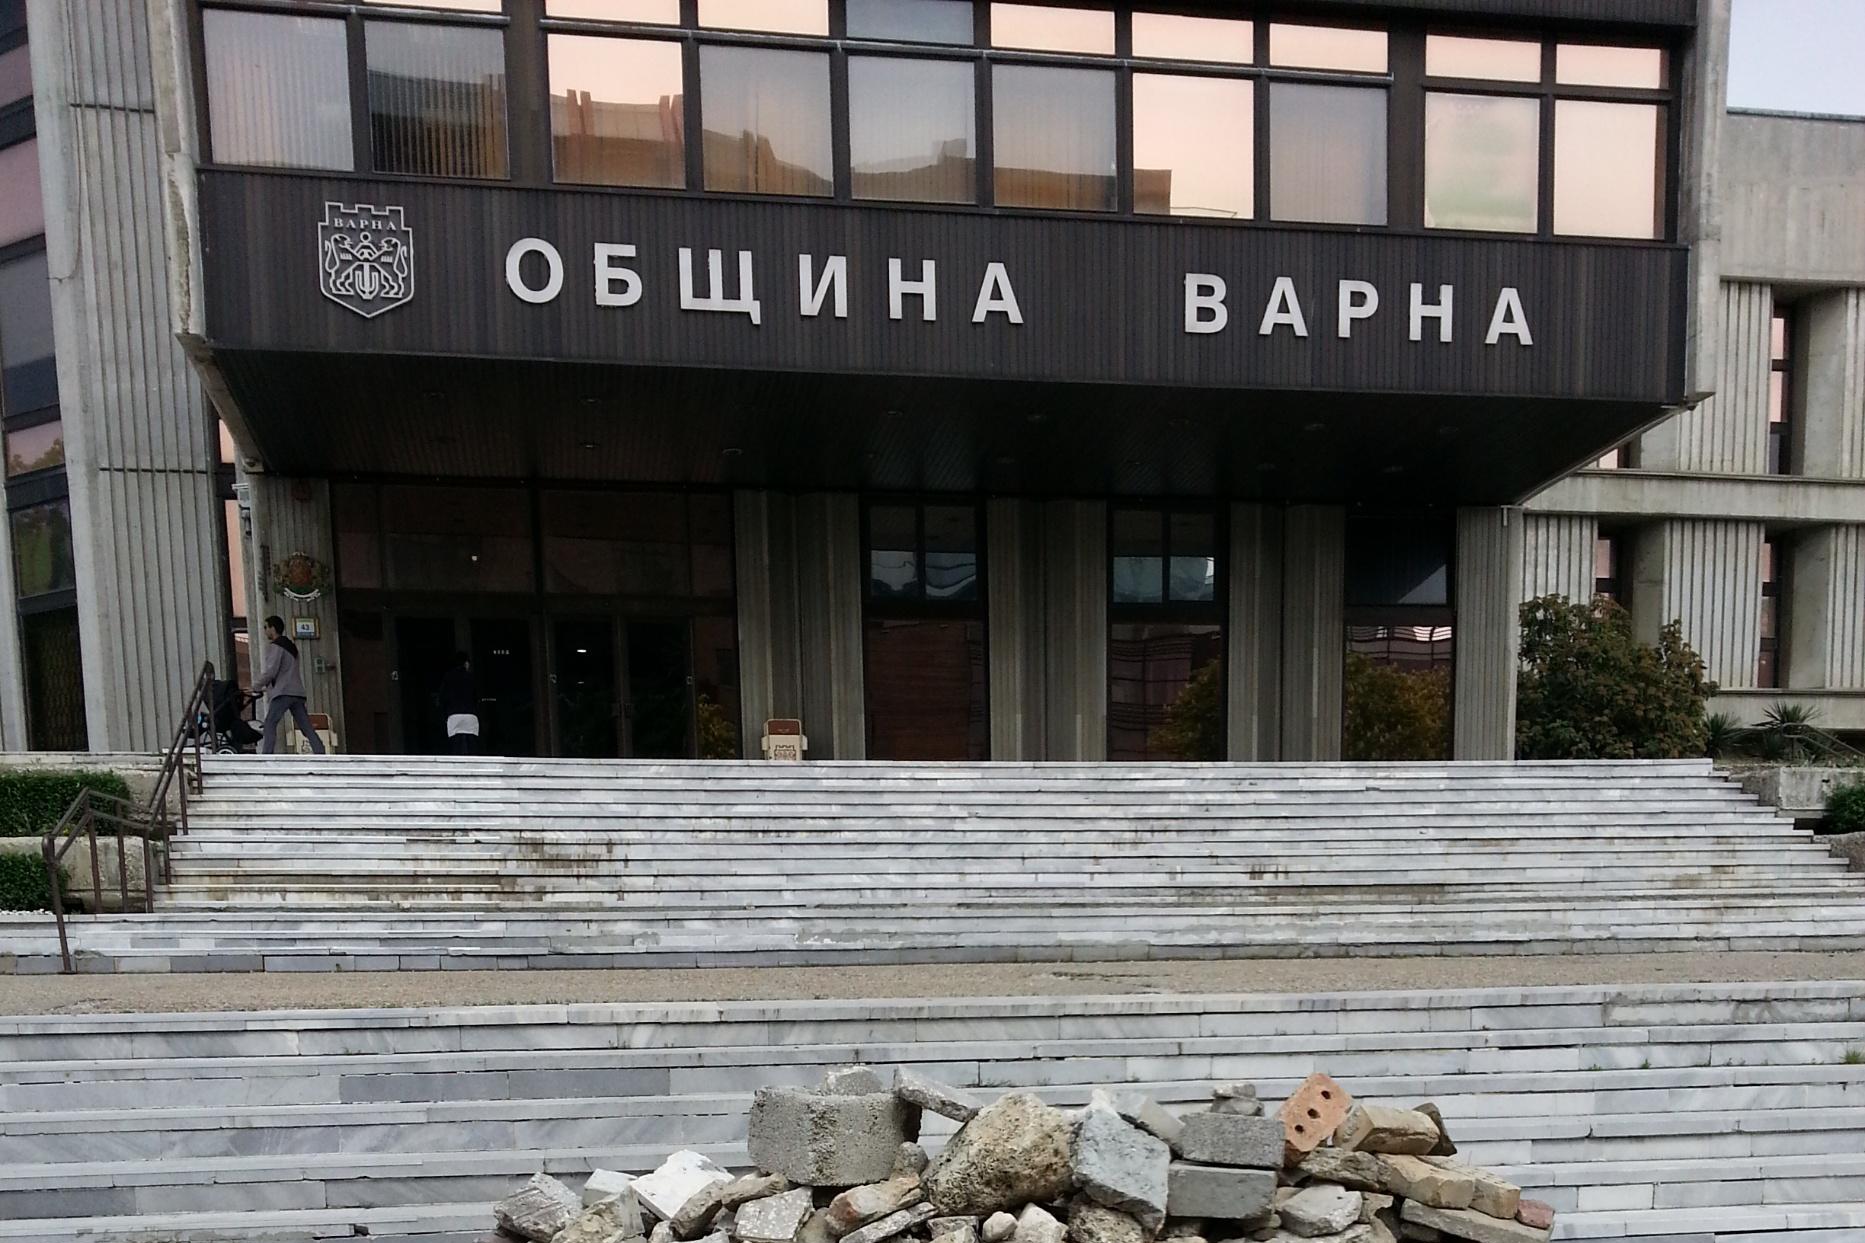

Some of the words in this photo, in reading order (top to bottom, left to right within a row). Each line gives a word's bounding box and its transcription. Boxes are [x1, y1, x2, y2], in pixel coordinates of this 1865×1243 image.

[334, 218, 396, 230] ВАРНА
[504, 237, 1024, 325] ОБЩИНА
[1184, 273, 1534, 346] ВАРНА
